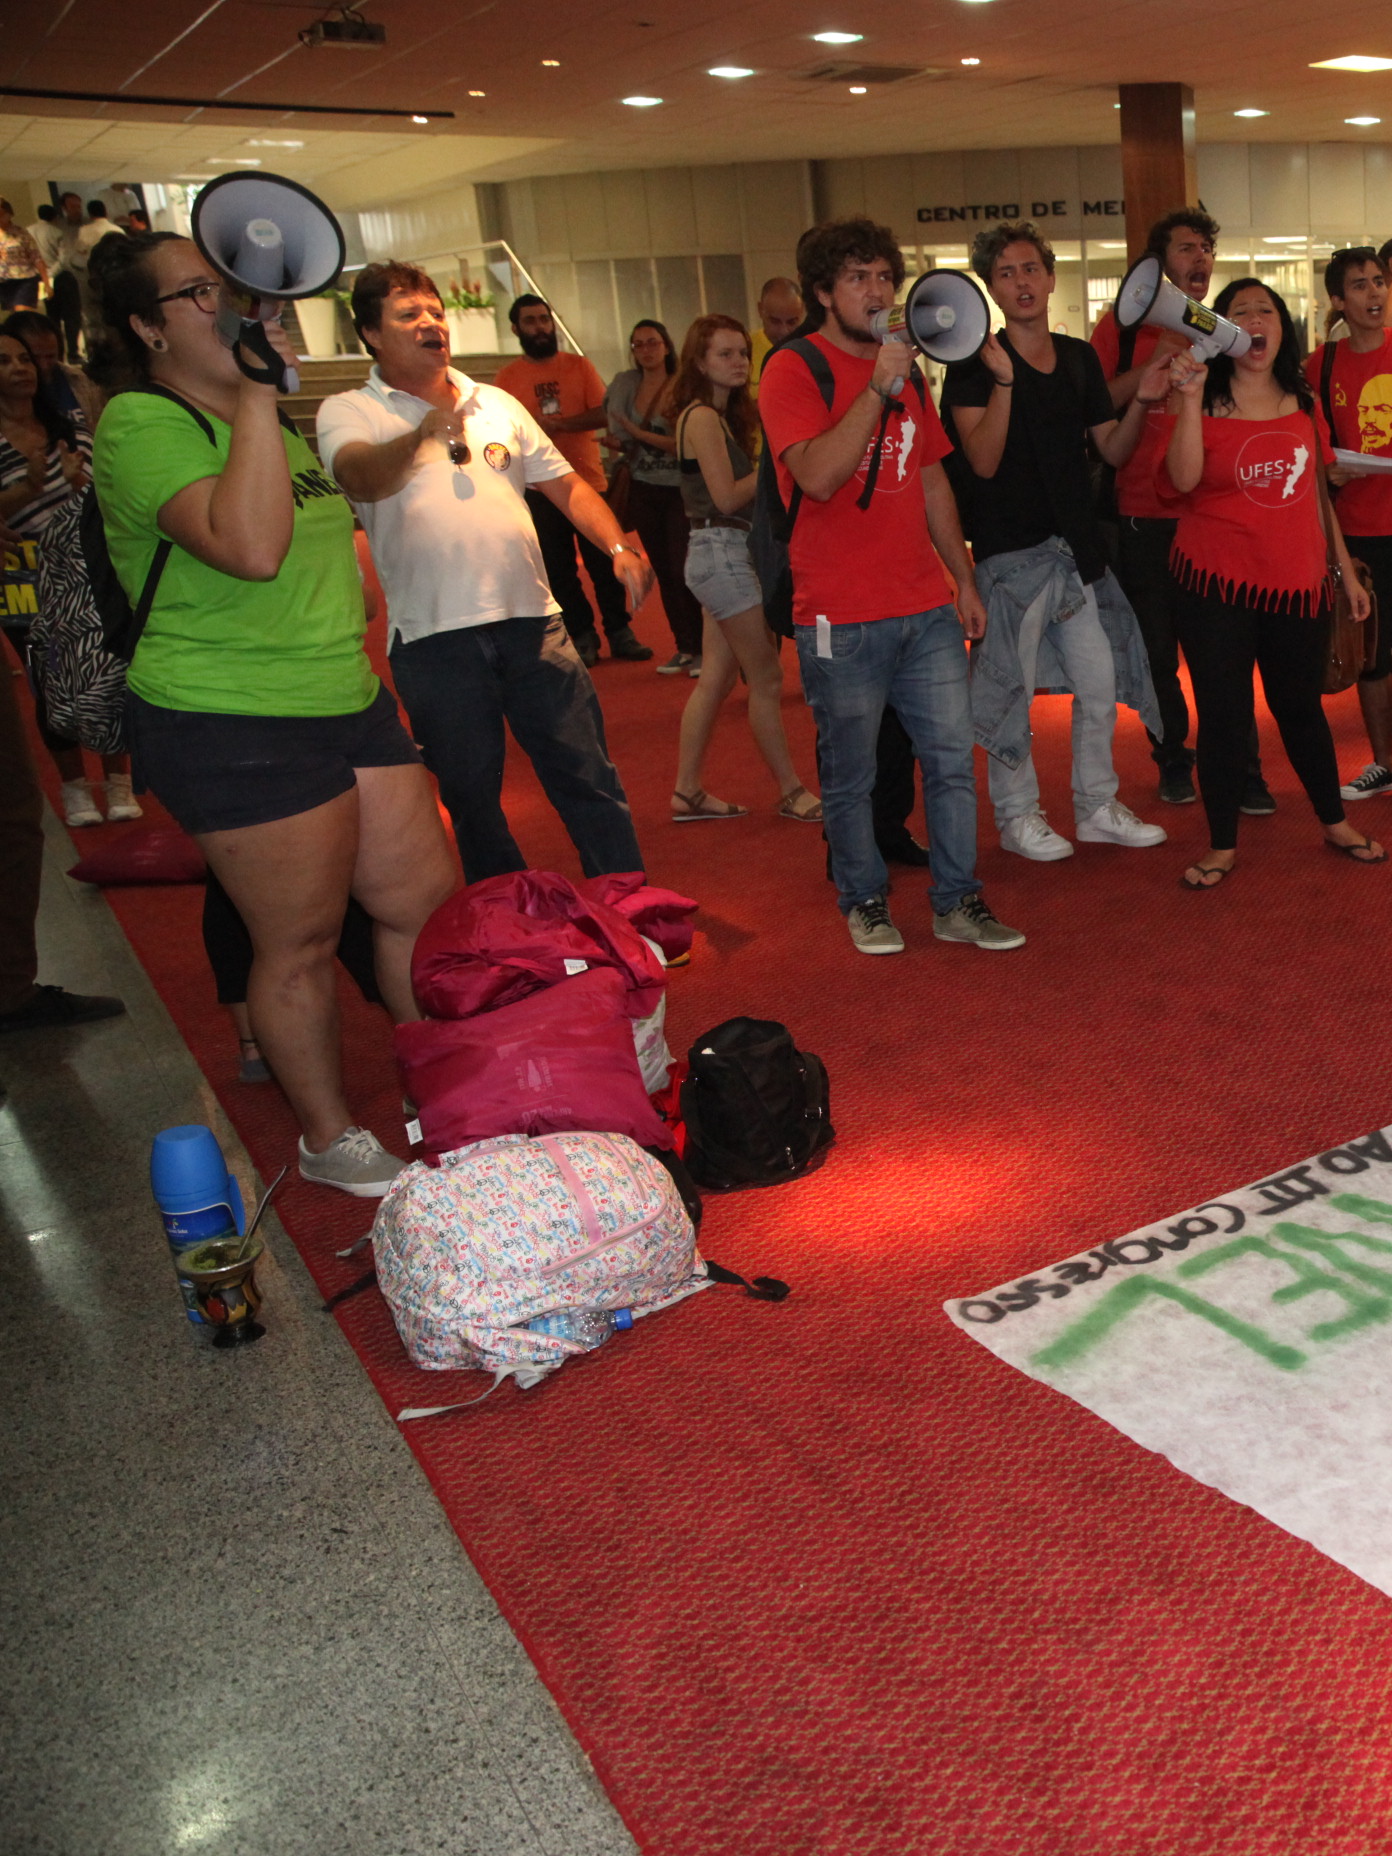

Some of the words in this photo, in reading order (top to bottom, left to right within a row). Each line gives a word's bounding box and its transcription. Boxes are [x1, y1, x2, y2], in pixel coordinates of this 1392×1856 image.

[917, 204, 1020, 222] CENTRO
[1032, 200, 1067, 217] DE
[1239, 459, 1285, 481] UFES
